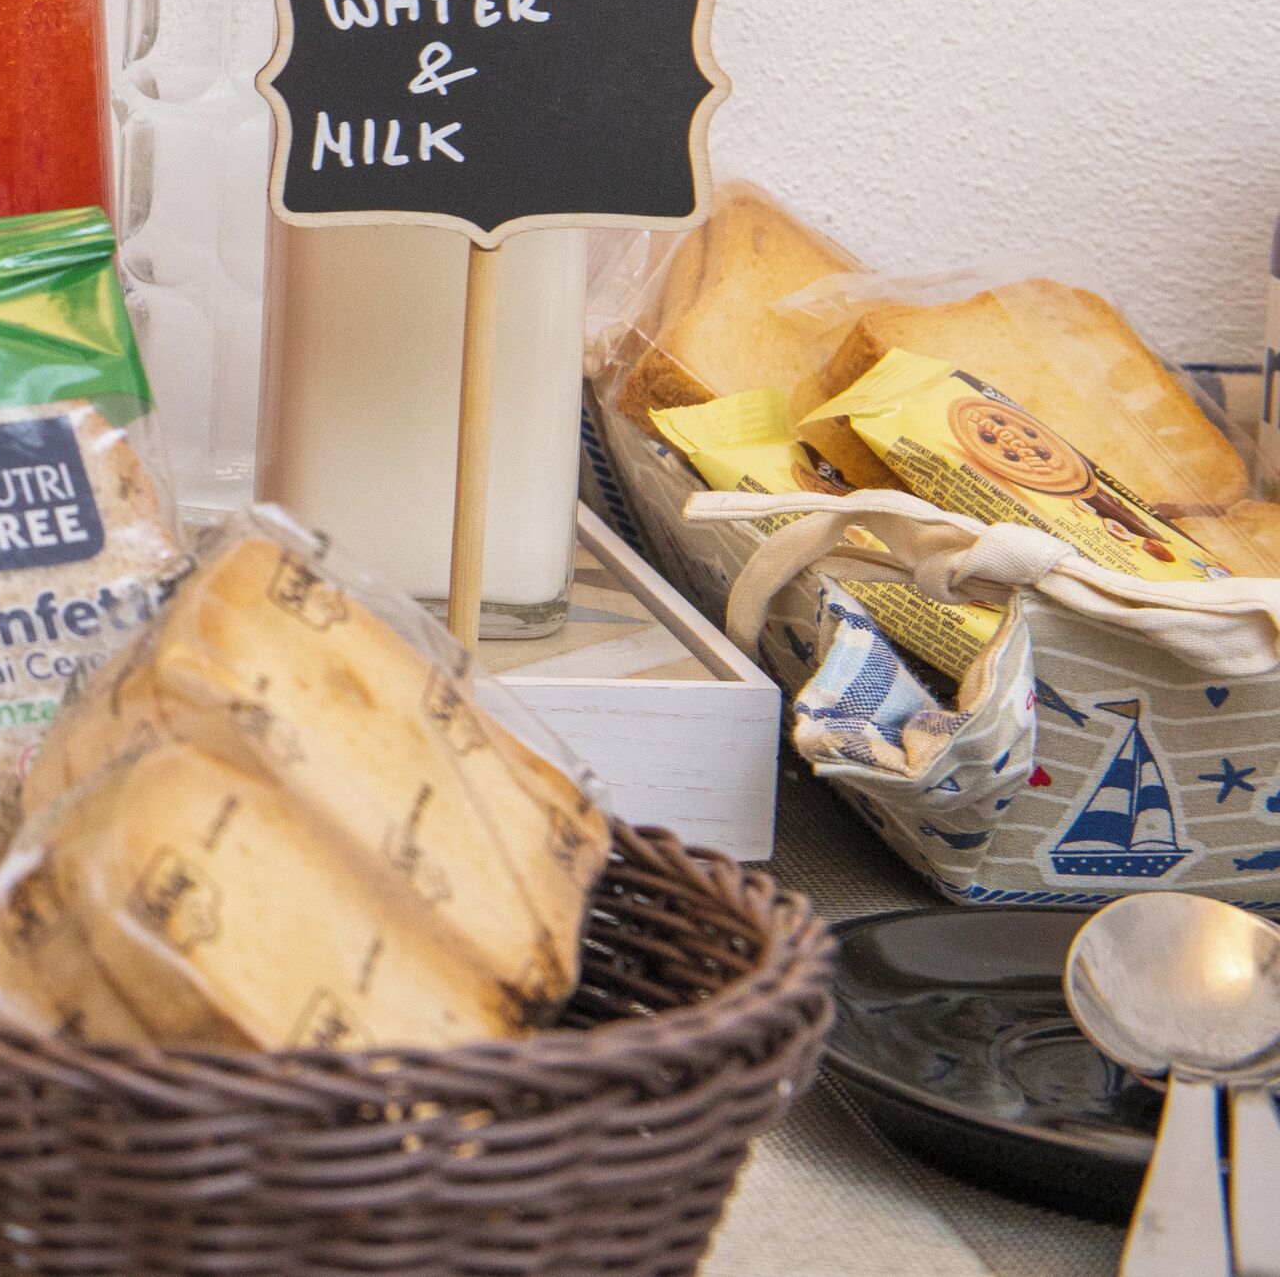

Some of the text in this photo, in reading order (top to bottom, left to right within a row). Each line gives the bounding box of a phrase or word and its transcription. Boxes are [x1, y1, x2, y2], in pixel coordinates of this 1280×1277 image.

[408, 41, 478, 95] &
[312, 112, 465, 171] MILK
[958, 462, 991, 488] BISCOTTI
[988, 483, 1015, 506] FARCITI
[1012, 502, 1029, 517] CON
[1027, 512, 1052, 534] CREMA
[1054, 516, 1082, 540] SENZA
[1082, 538, 1105, 557] OLIO
[1104, 554, 1116, 565] DI
[939, 606, 966, 625] CACAO
